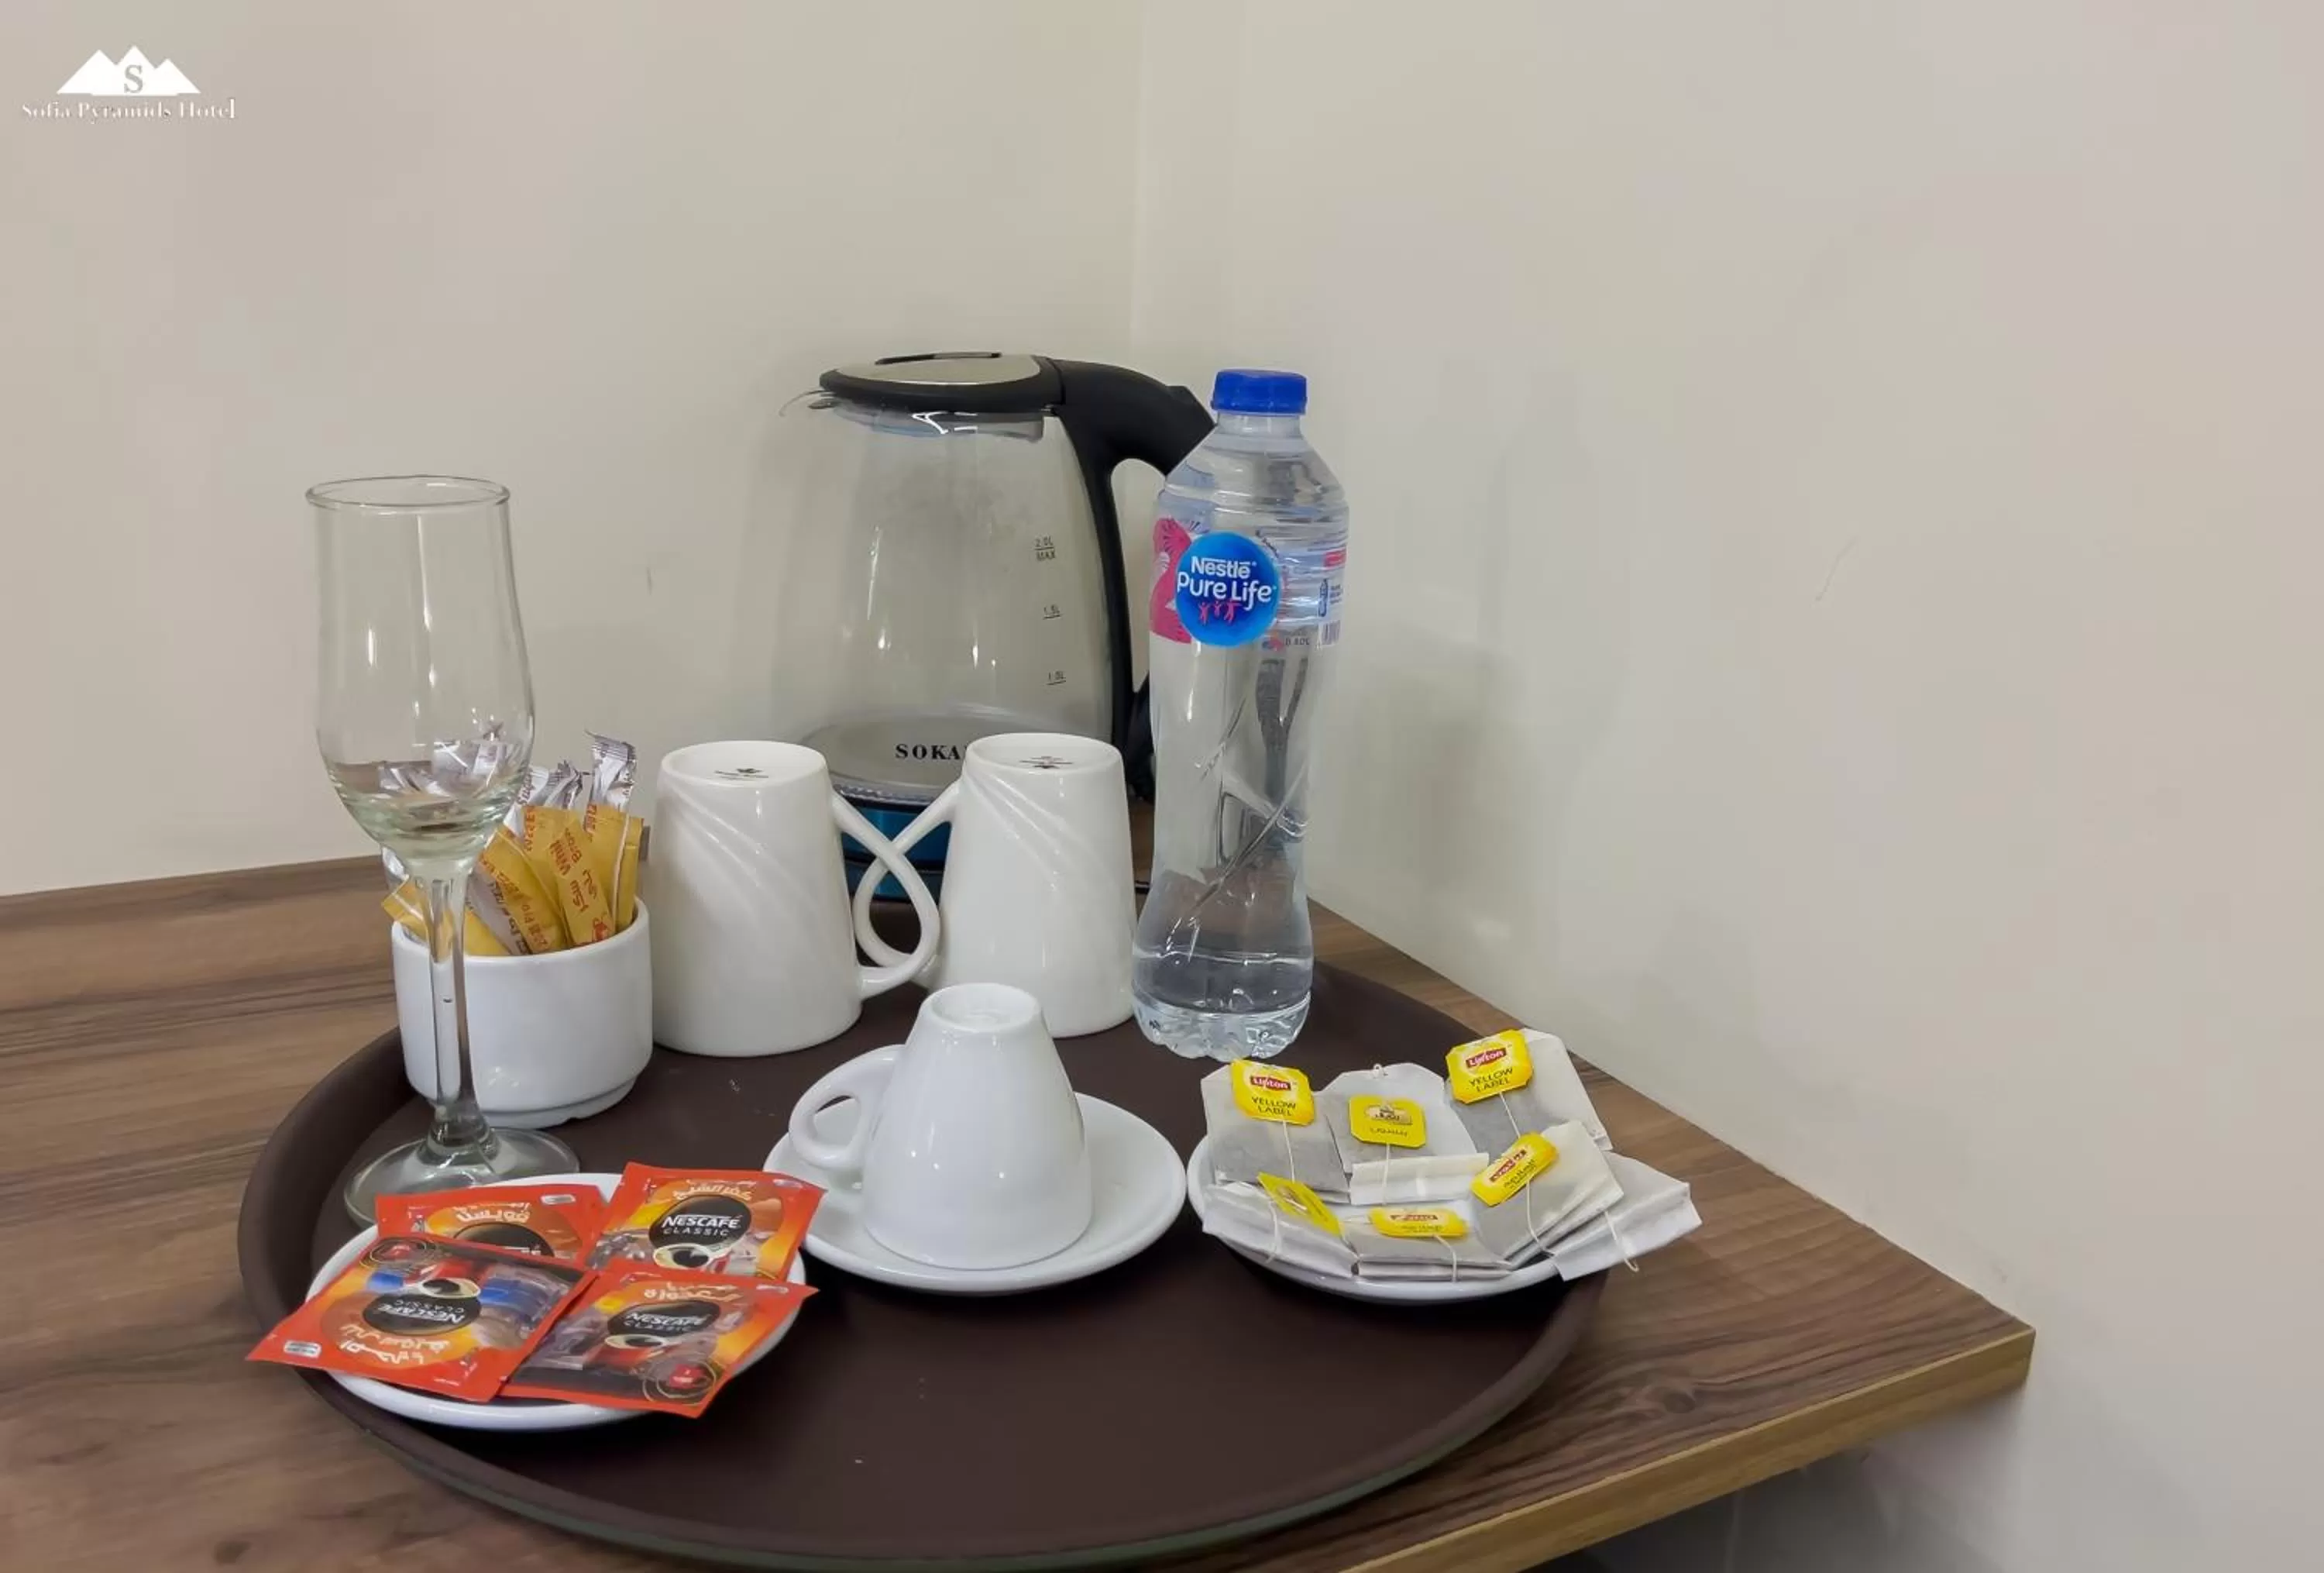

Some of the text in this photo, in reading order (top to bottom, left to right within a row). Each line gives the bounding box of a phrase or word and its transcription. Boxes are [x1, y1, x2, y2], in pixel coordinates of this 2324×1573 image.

[1177, 571, 1272, 611] Pure Life
[896, 744, 968, 760] SOKA
[1469, 1048, 1505, 1067] Lipton
[1252, 1076, 1290, 1090] Lipton
[1469, 1067, 1513, 1086] YELLOW
[1476, 1077, 1510, 1092] LABEL
[1252, 1096, 1296, 1110] YELLOW
[1258, 1106, 1292, 1116] LABEL
[662, 1227, 729, 1237] CLASSIC
